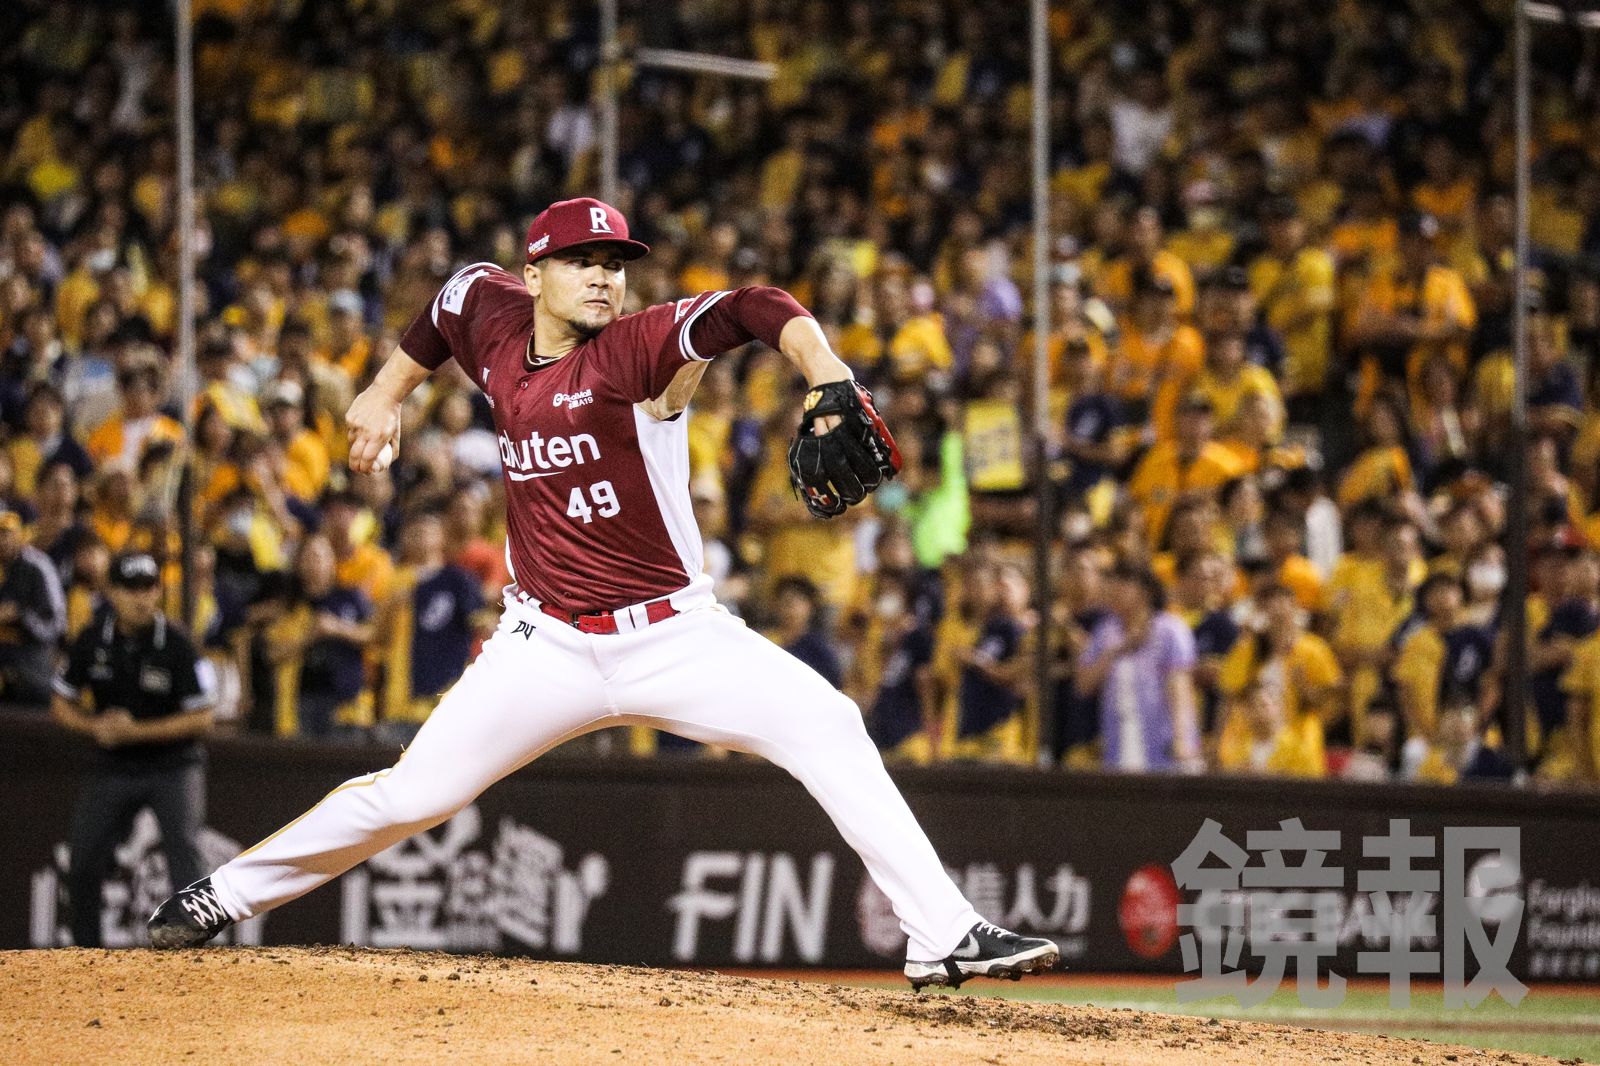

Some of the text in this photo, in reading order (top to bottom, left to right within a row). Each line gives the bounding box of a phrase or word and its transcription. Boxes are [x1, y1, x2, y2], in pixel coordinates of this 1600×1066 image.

[590, 207, 613, 232] R
[498, 429, 601, 472] akuten
[566, 480, 621, 524] 49
[670, 850, 835, 963] FIN
